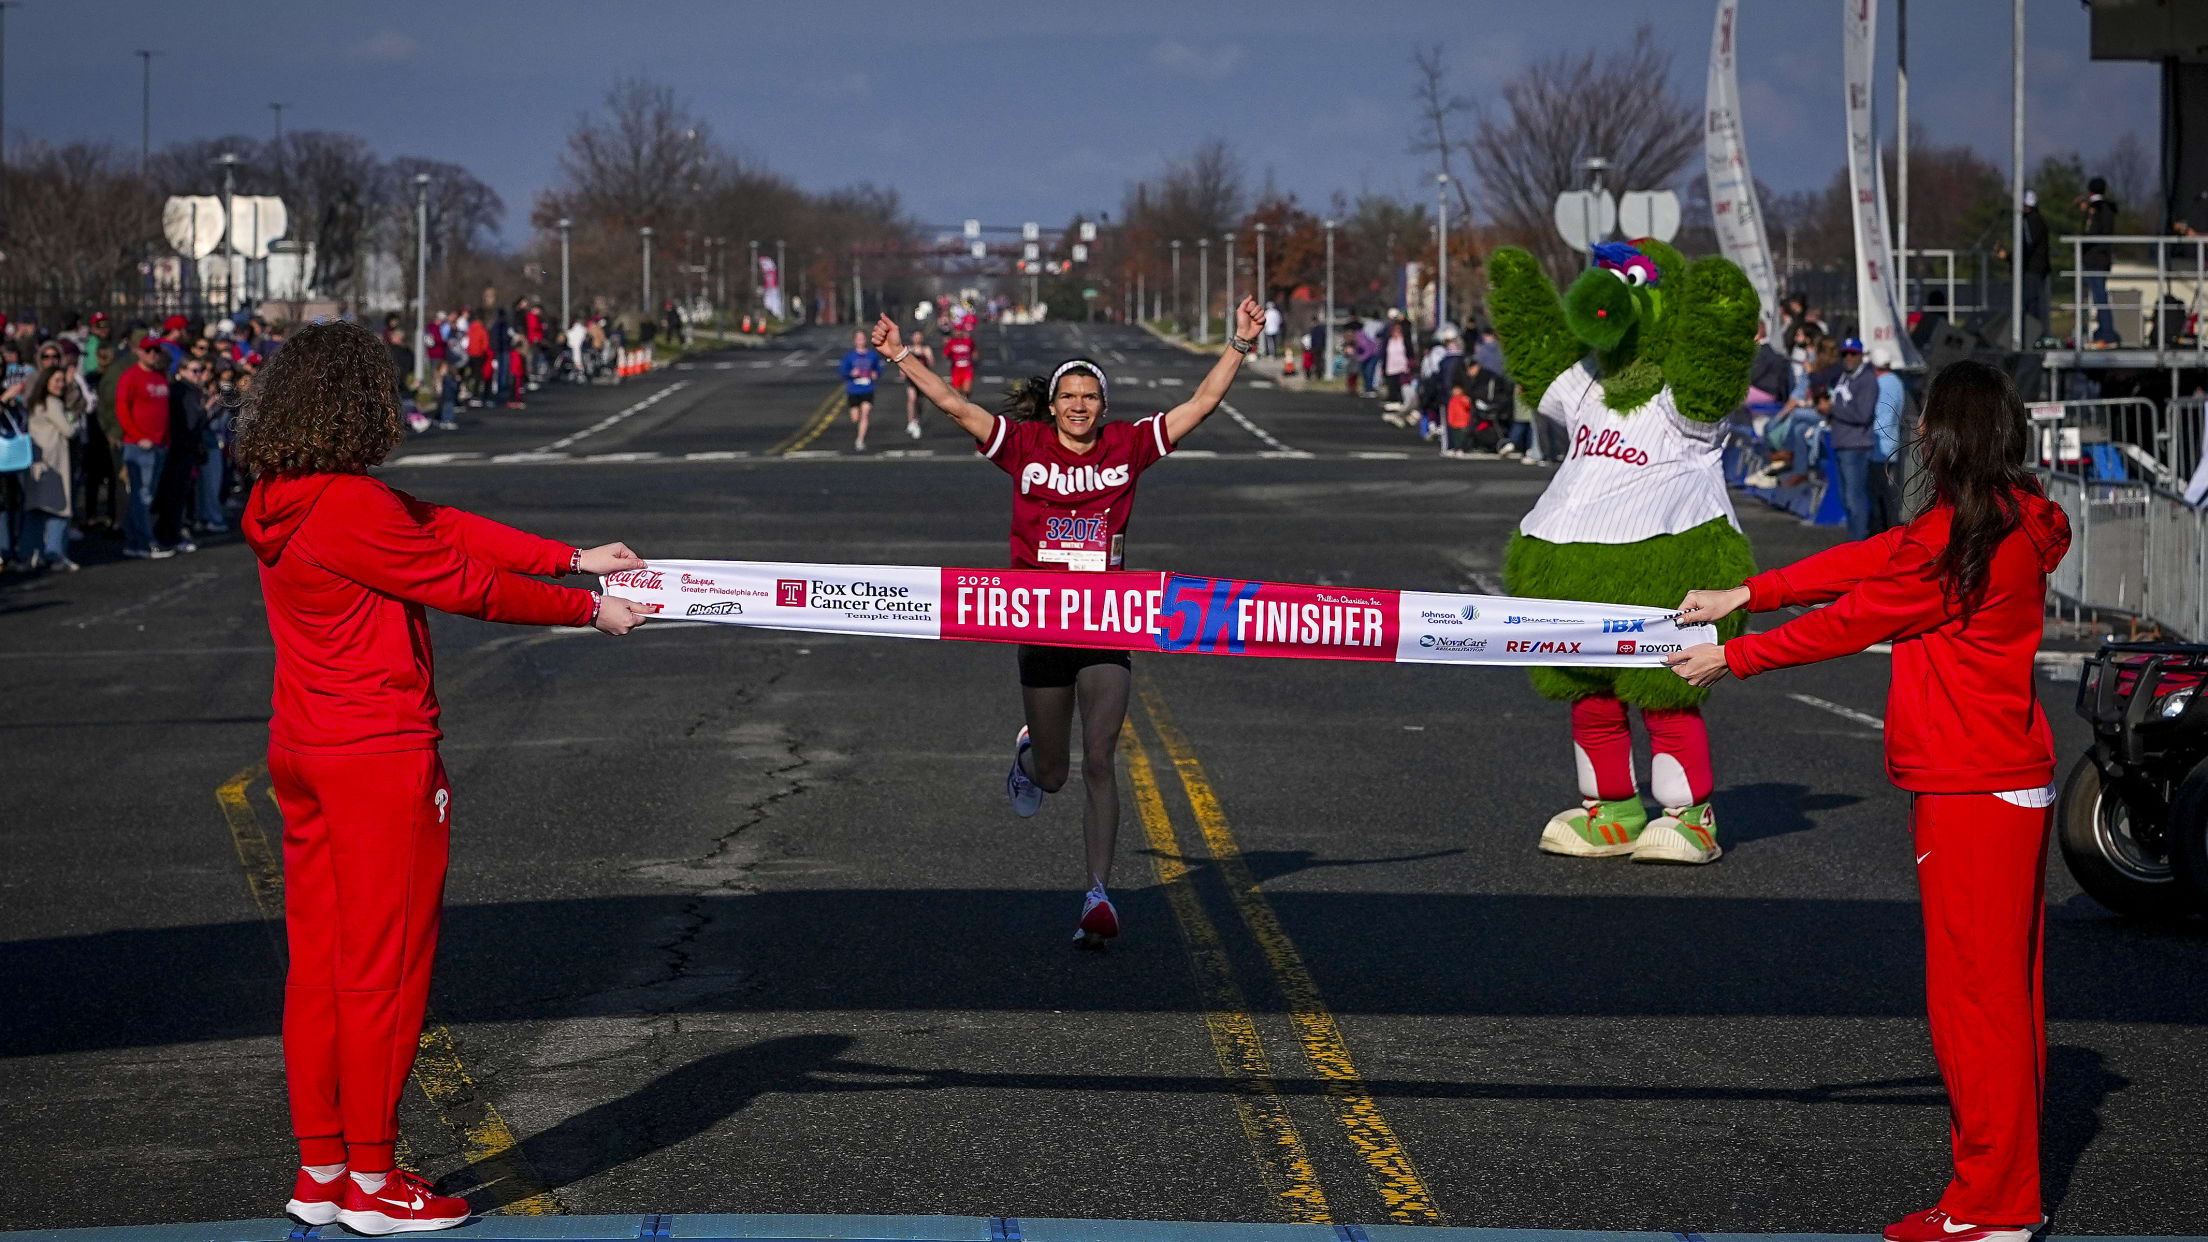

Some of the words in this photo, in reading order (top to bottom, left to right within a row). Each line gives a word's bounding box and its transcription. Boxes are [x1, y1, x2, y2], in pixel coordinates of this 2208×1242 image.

[1021, 462, 1129, 495] Phillies
[1046, 517, 1101, 542] 3207
[606, 570, 664, 590] Coca-Cola
[957, 576, 1001, 585] 2026
[681, 585, 707, 594] Greater
[709, 587, 750, 597] Philadelphia
[811, 580, 847, 595] Fox
[851, 582, 909, 598] Chase
[810, 596, 870, 610] Cancer
[874, 599, 932, 613] Center
[957, 587, 1051, 629] FIRST
[1060, 589, 1161, 636] PLACE
[845, 612, 889, 621] Temple
[1153, 576, 1263, 653] 5K
[1421, 610, 1456, 619] Johnson
[1504, 616, 1521, 624] J&J
[1237, 598, 1383, 647] FINISHER
[1602, 618, 1646, 633] IBX
[1436, 637, 1487, 647] NovaCare
[1506, 641, 1582, 653] RE/MAX
[1640, 644, 1682, 653] TOYOTA
